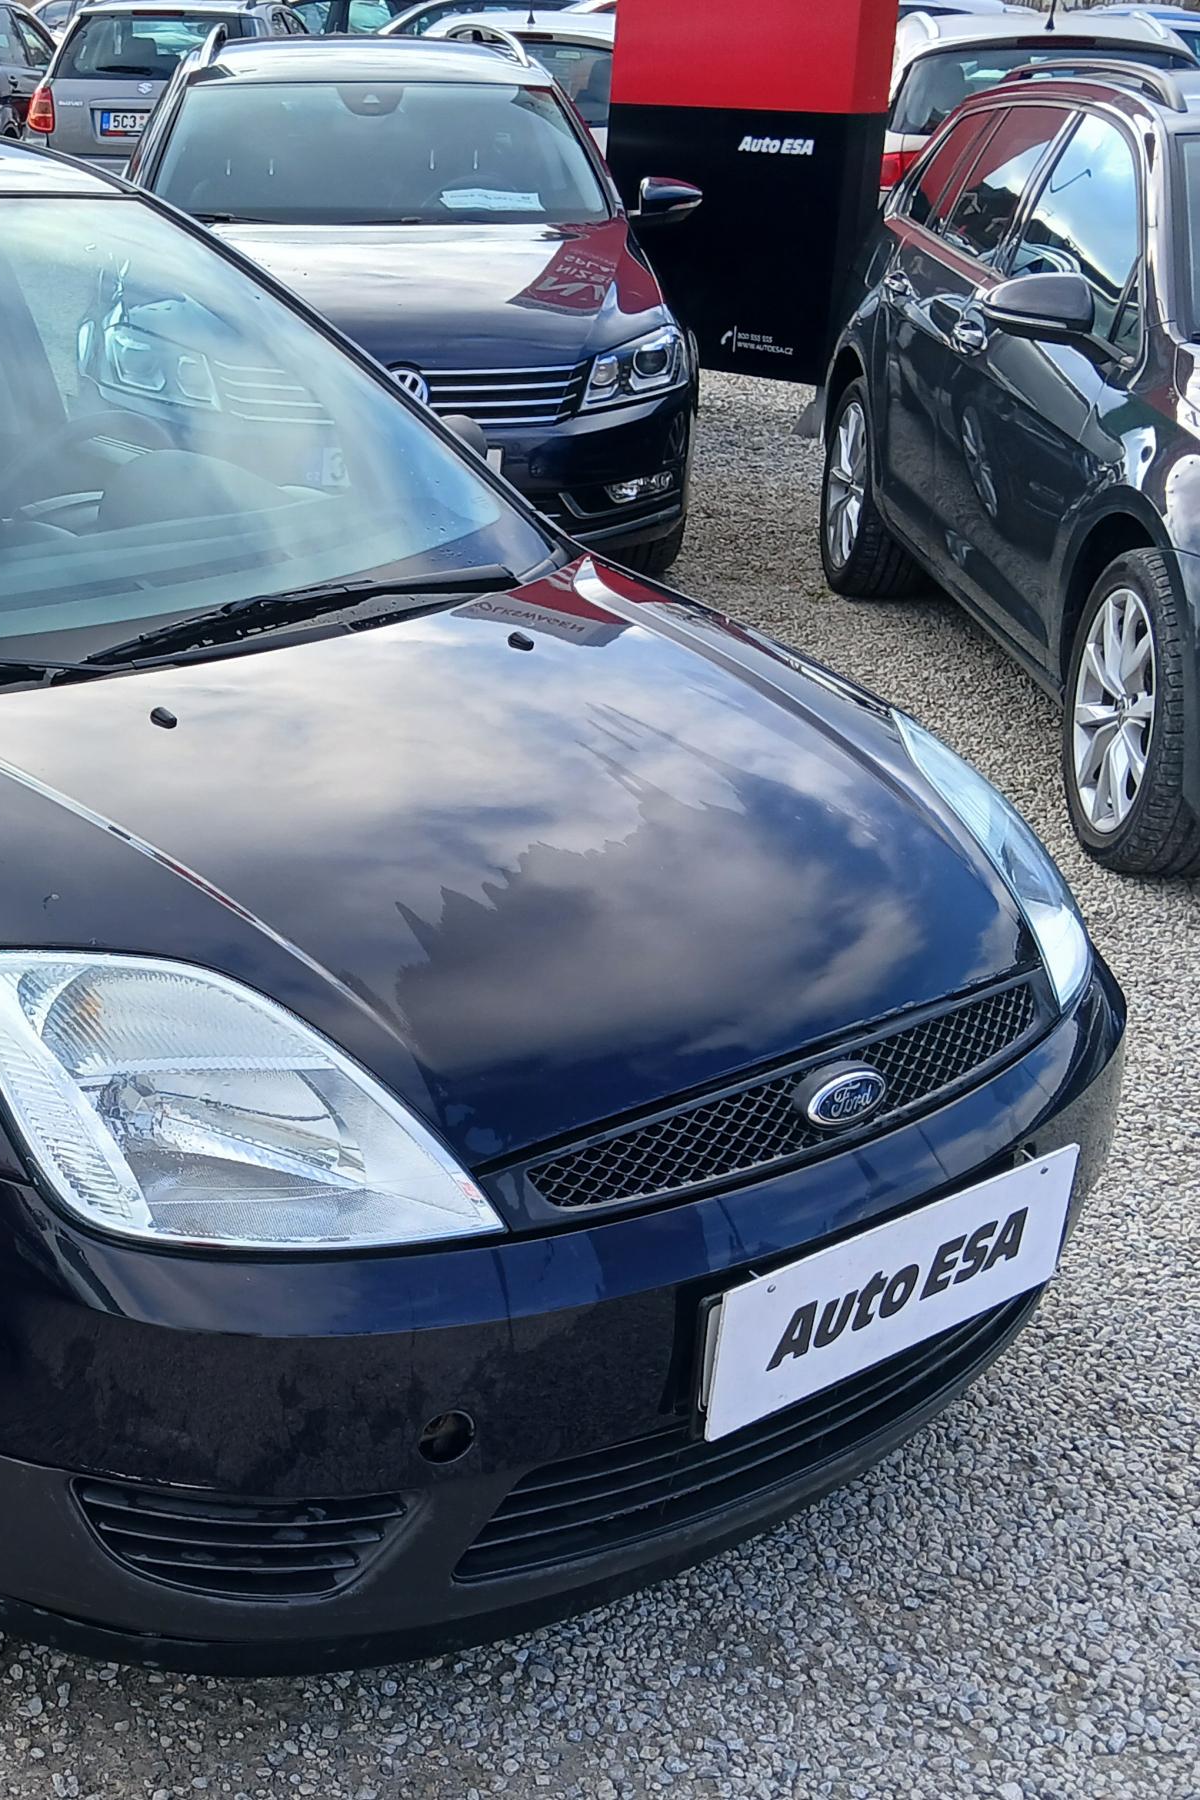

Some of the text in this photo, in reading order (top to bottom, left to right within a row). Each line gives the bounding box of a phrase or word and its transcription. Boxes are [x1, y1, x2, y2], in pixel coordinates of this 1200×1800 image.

[780, 138, 815, 155] ESA
[830, 1081, 873, 1117] Ford
[765, 1206, 1029, 1371] Auto ESA
